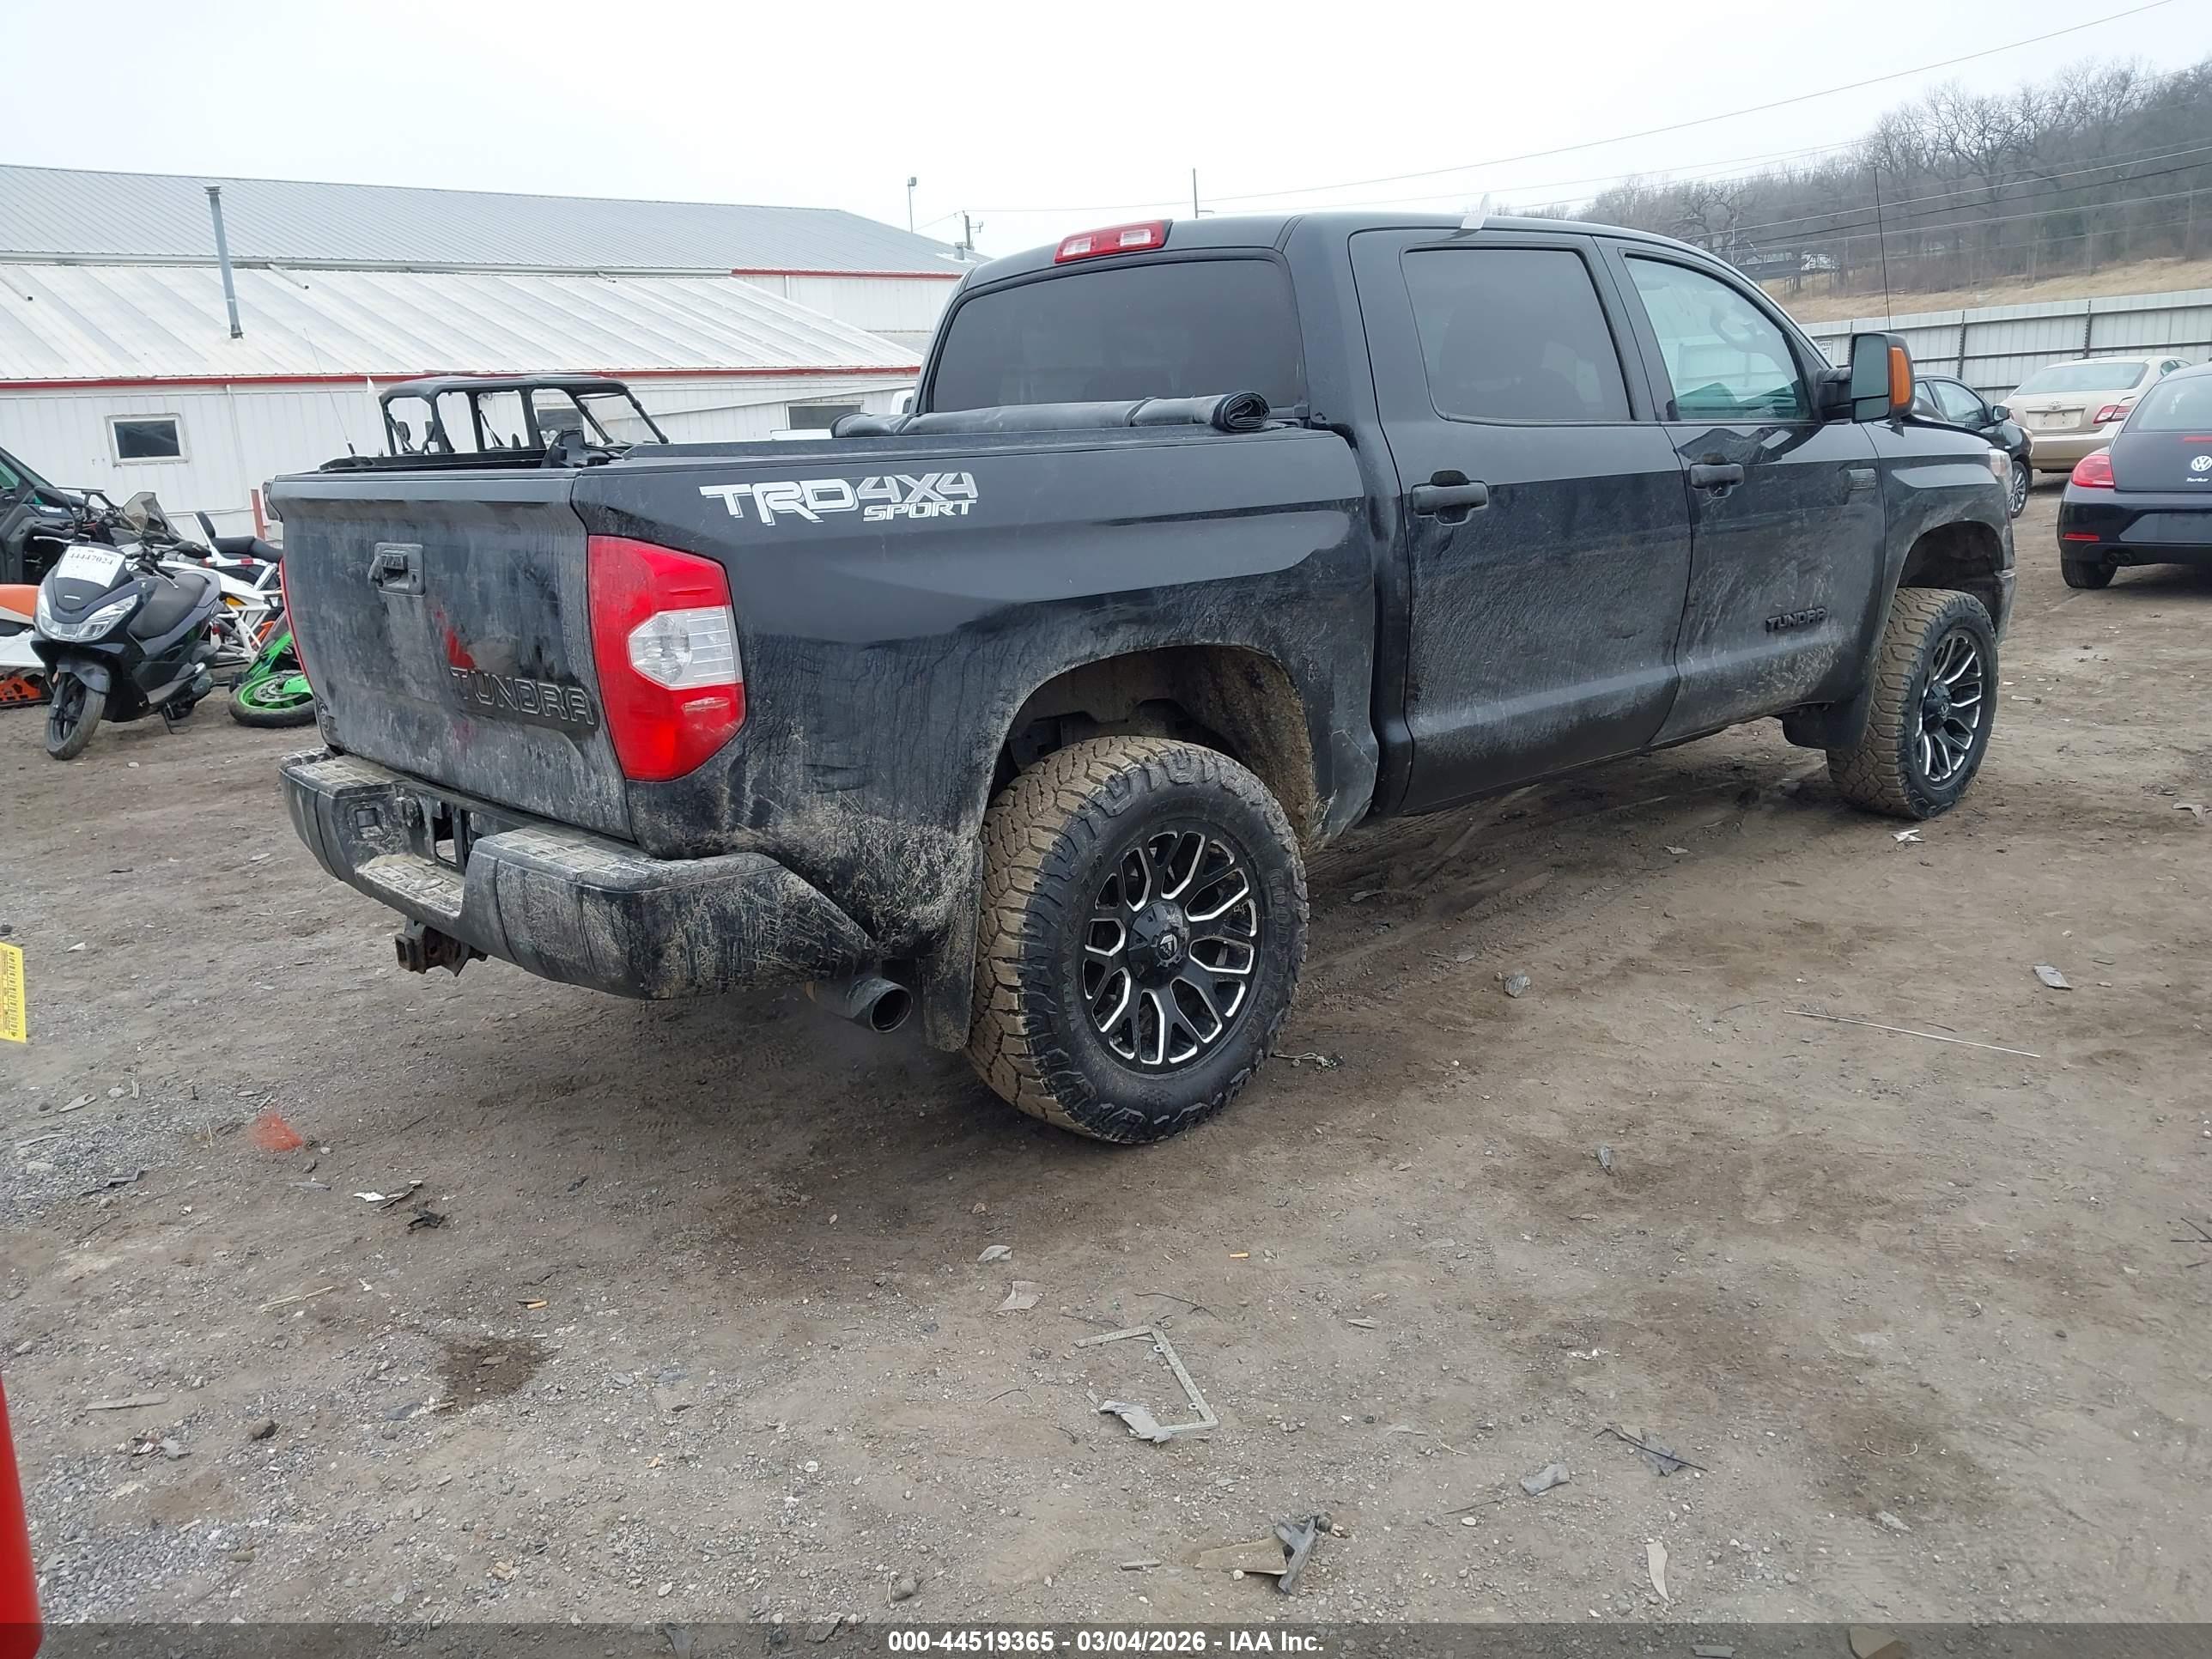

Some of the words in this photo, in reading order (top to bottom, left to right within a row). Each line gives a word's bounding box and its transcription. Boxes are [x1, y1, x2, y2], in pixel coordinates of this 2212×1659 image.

[699, 478, 859, 526] TRD
[863, 499, 977, 521] SPORT
[69, 553, 113, 565] 44447024
[1765, 606, 1827, 632] TUNDRA
[449, 665, 595, 726] TUNDRA
